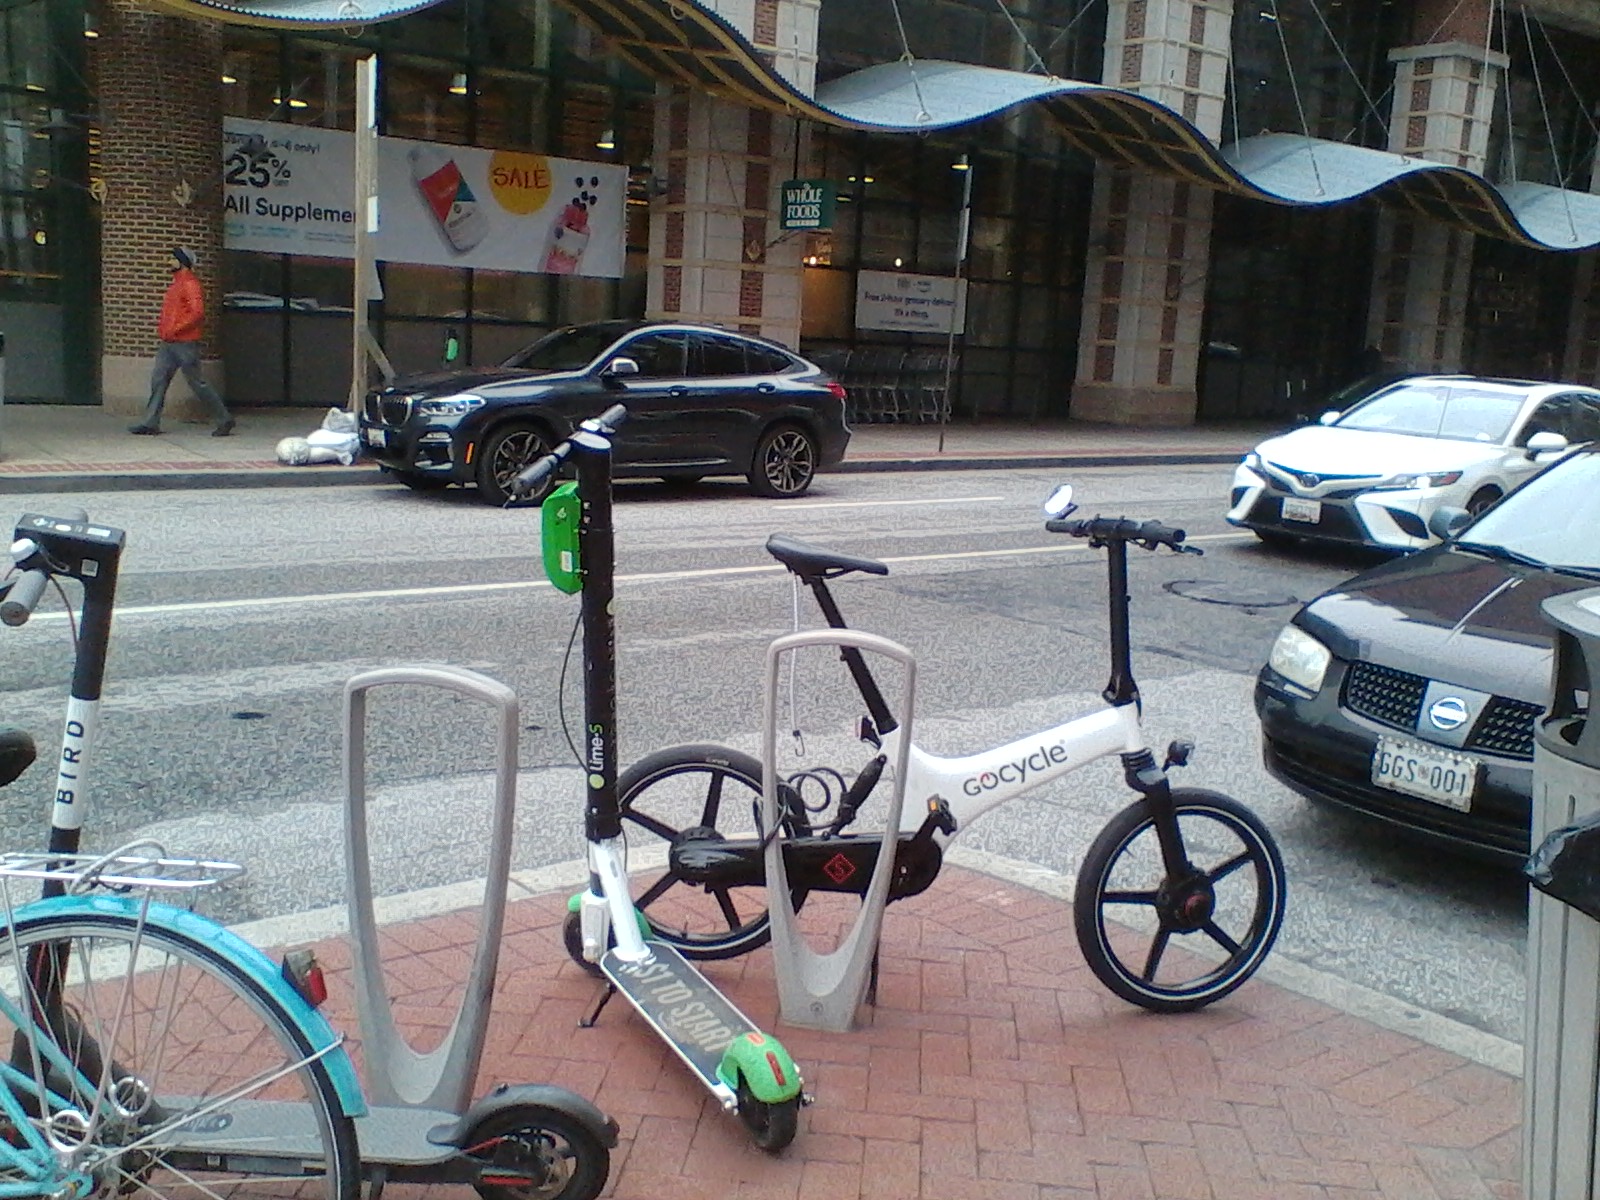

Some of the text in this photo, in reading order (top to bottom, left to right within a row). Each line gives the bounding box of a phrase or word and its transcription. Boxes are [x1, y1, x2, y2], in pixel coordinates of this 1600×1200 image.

[493, 164, 549, 189] SALE
[786, 188, 823, 203] WHOLE
[225, 195, 356, 225] All Suppleme
[786, 203, 821, 219] FOODS
[57, 720, 84, 804] BIRD
[1379, 751, 1417, 783] GGS
[1430, 765, 1466, 796] 001
[651, 979, 692, 1005] TO
